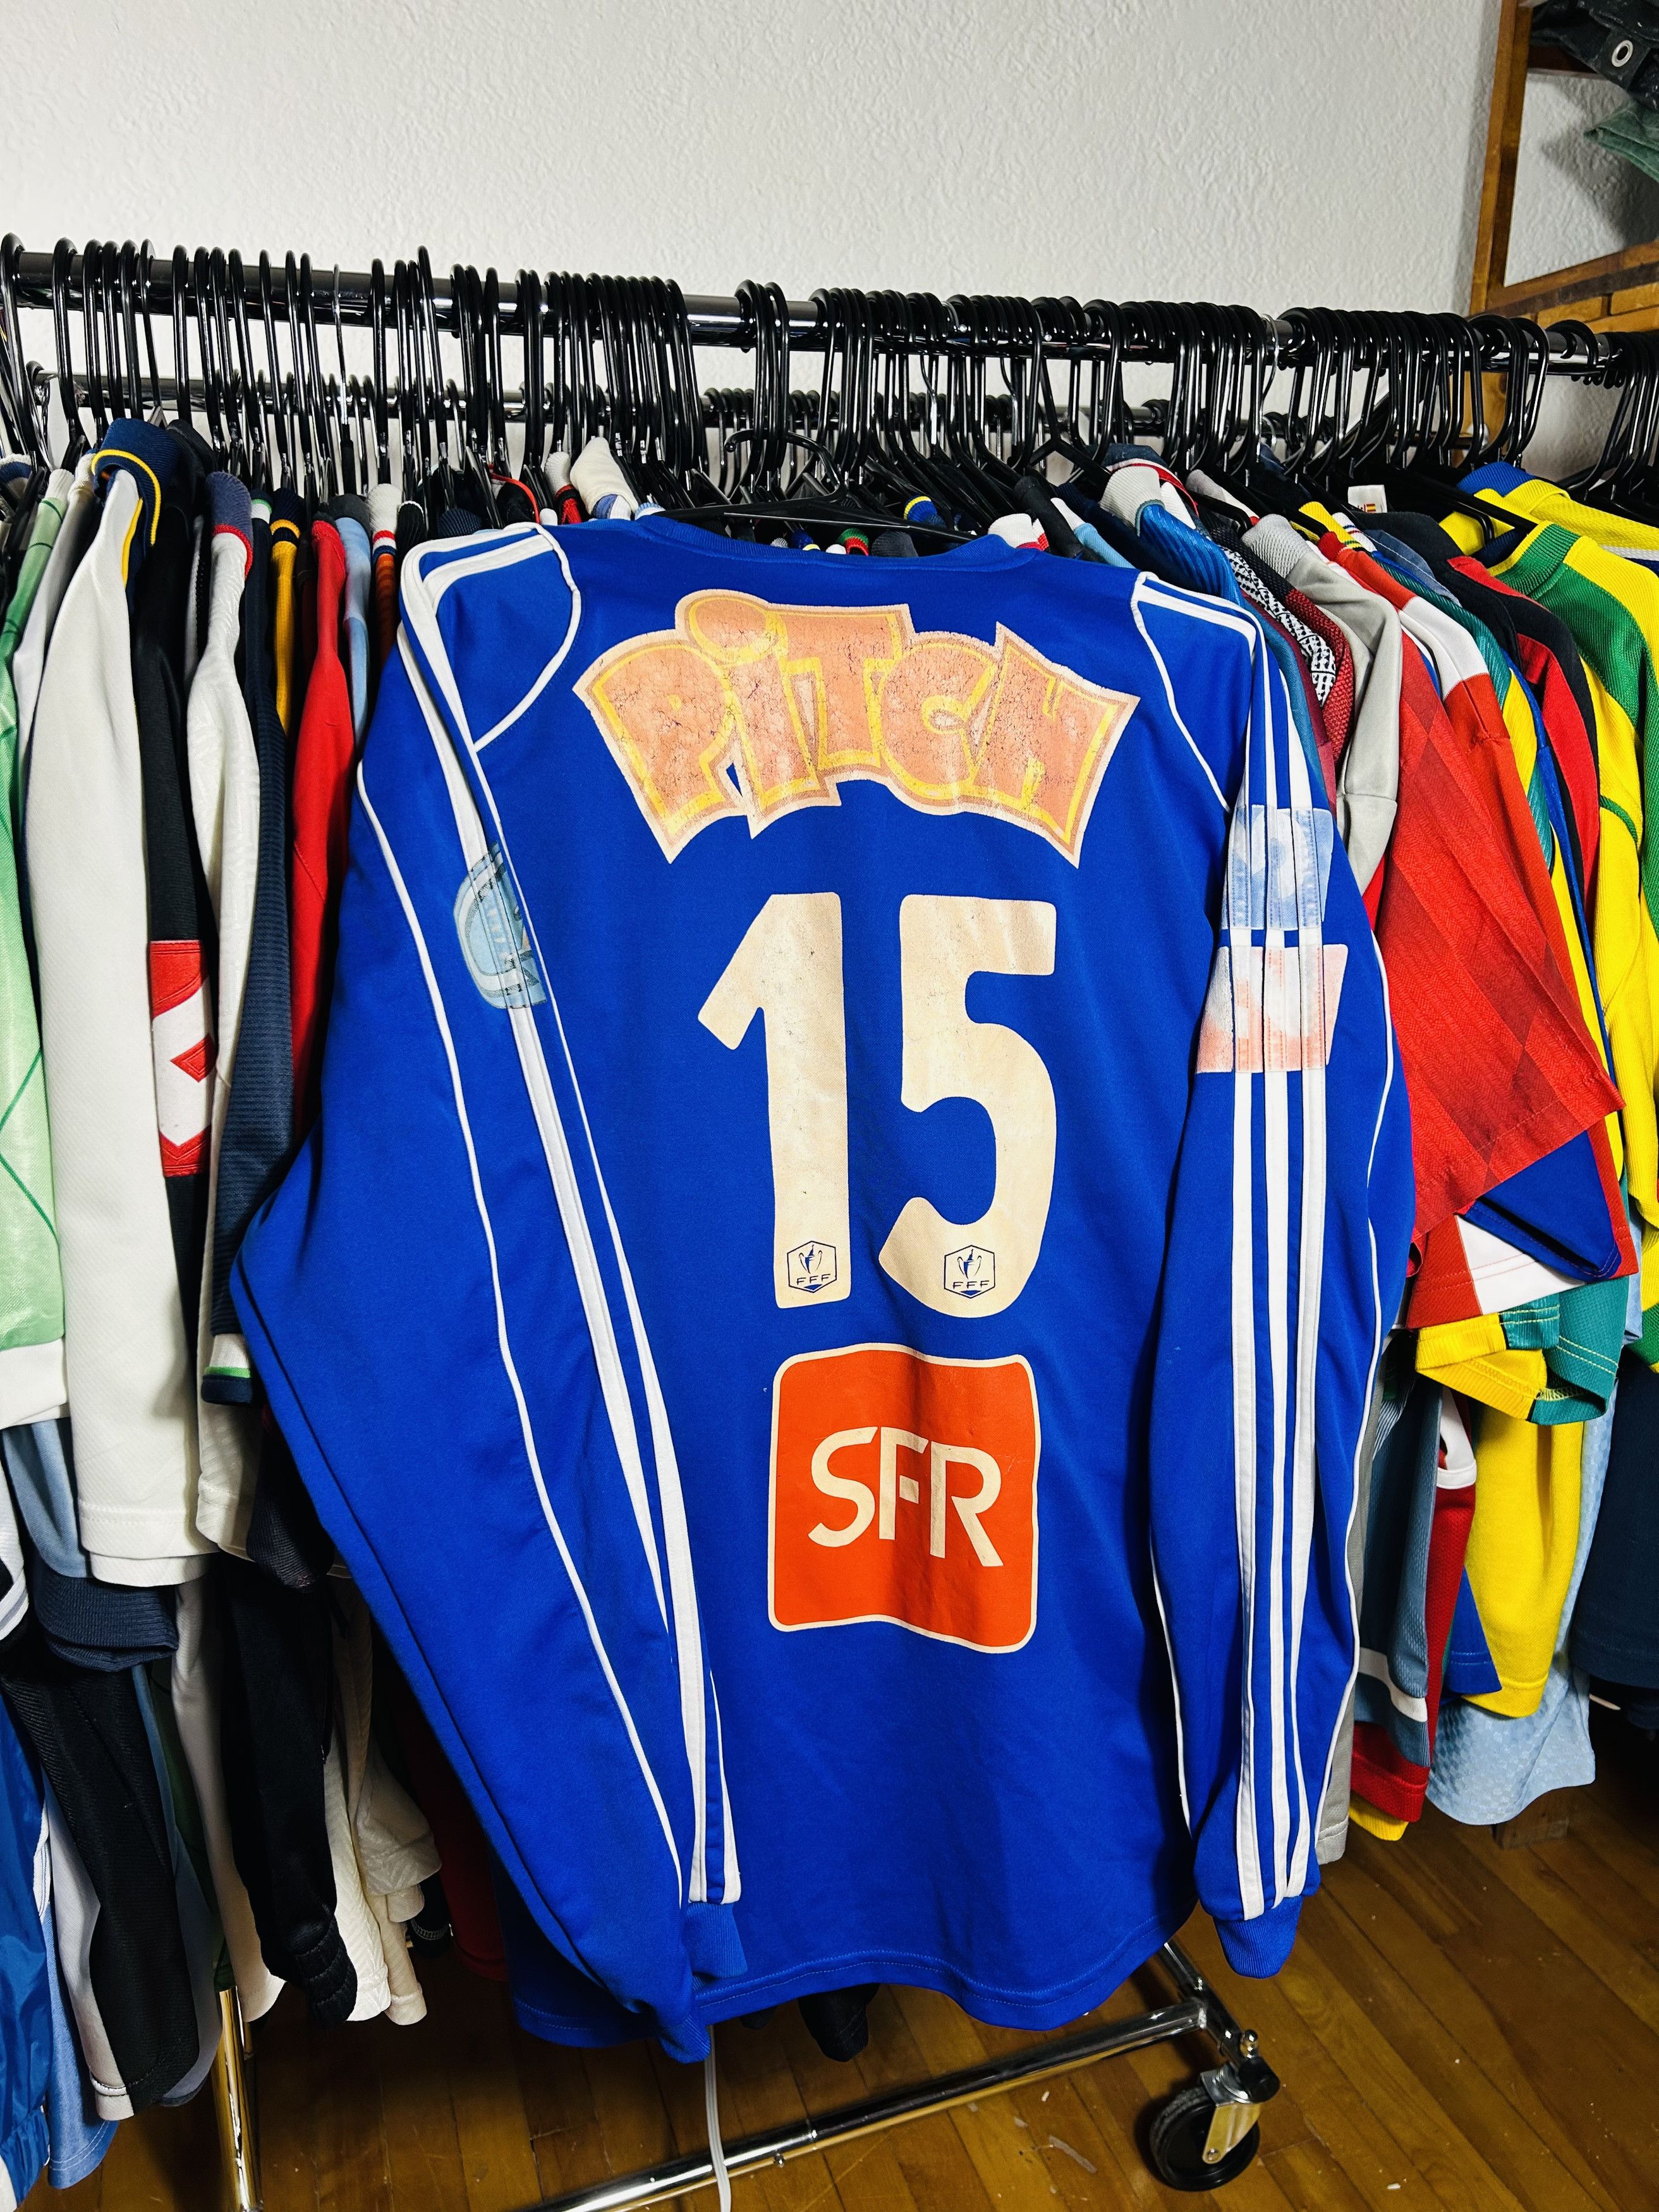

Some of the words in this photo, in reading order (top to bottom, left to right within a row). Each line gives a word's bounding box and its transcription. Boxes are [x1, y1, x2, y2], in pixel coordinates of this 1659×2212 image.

[698, 892, 1057, 1318] 15
[796, 1273, 831, 1285] FFF
[952, 1280, 990, 1289] FFF
[808, 1426, 1004, 1567] SFR
